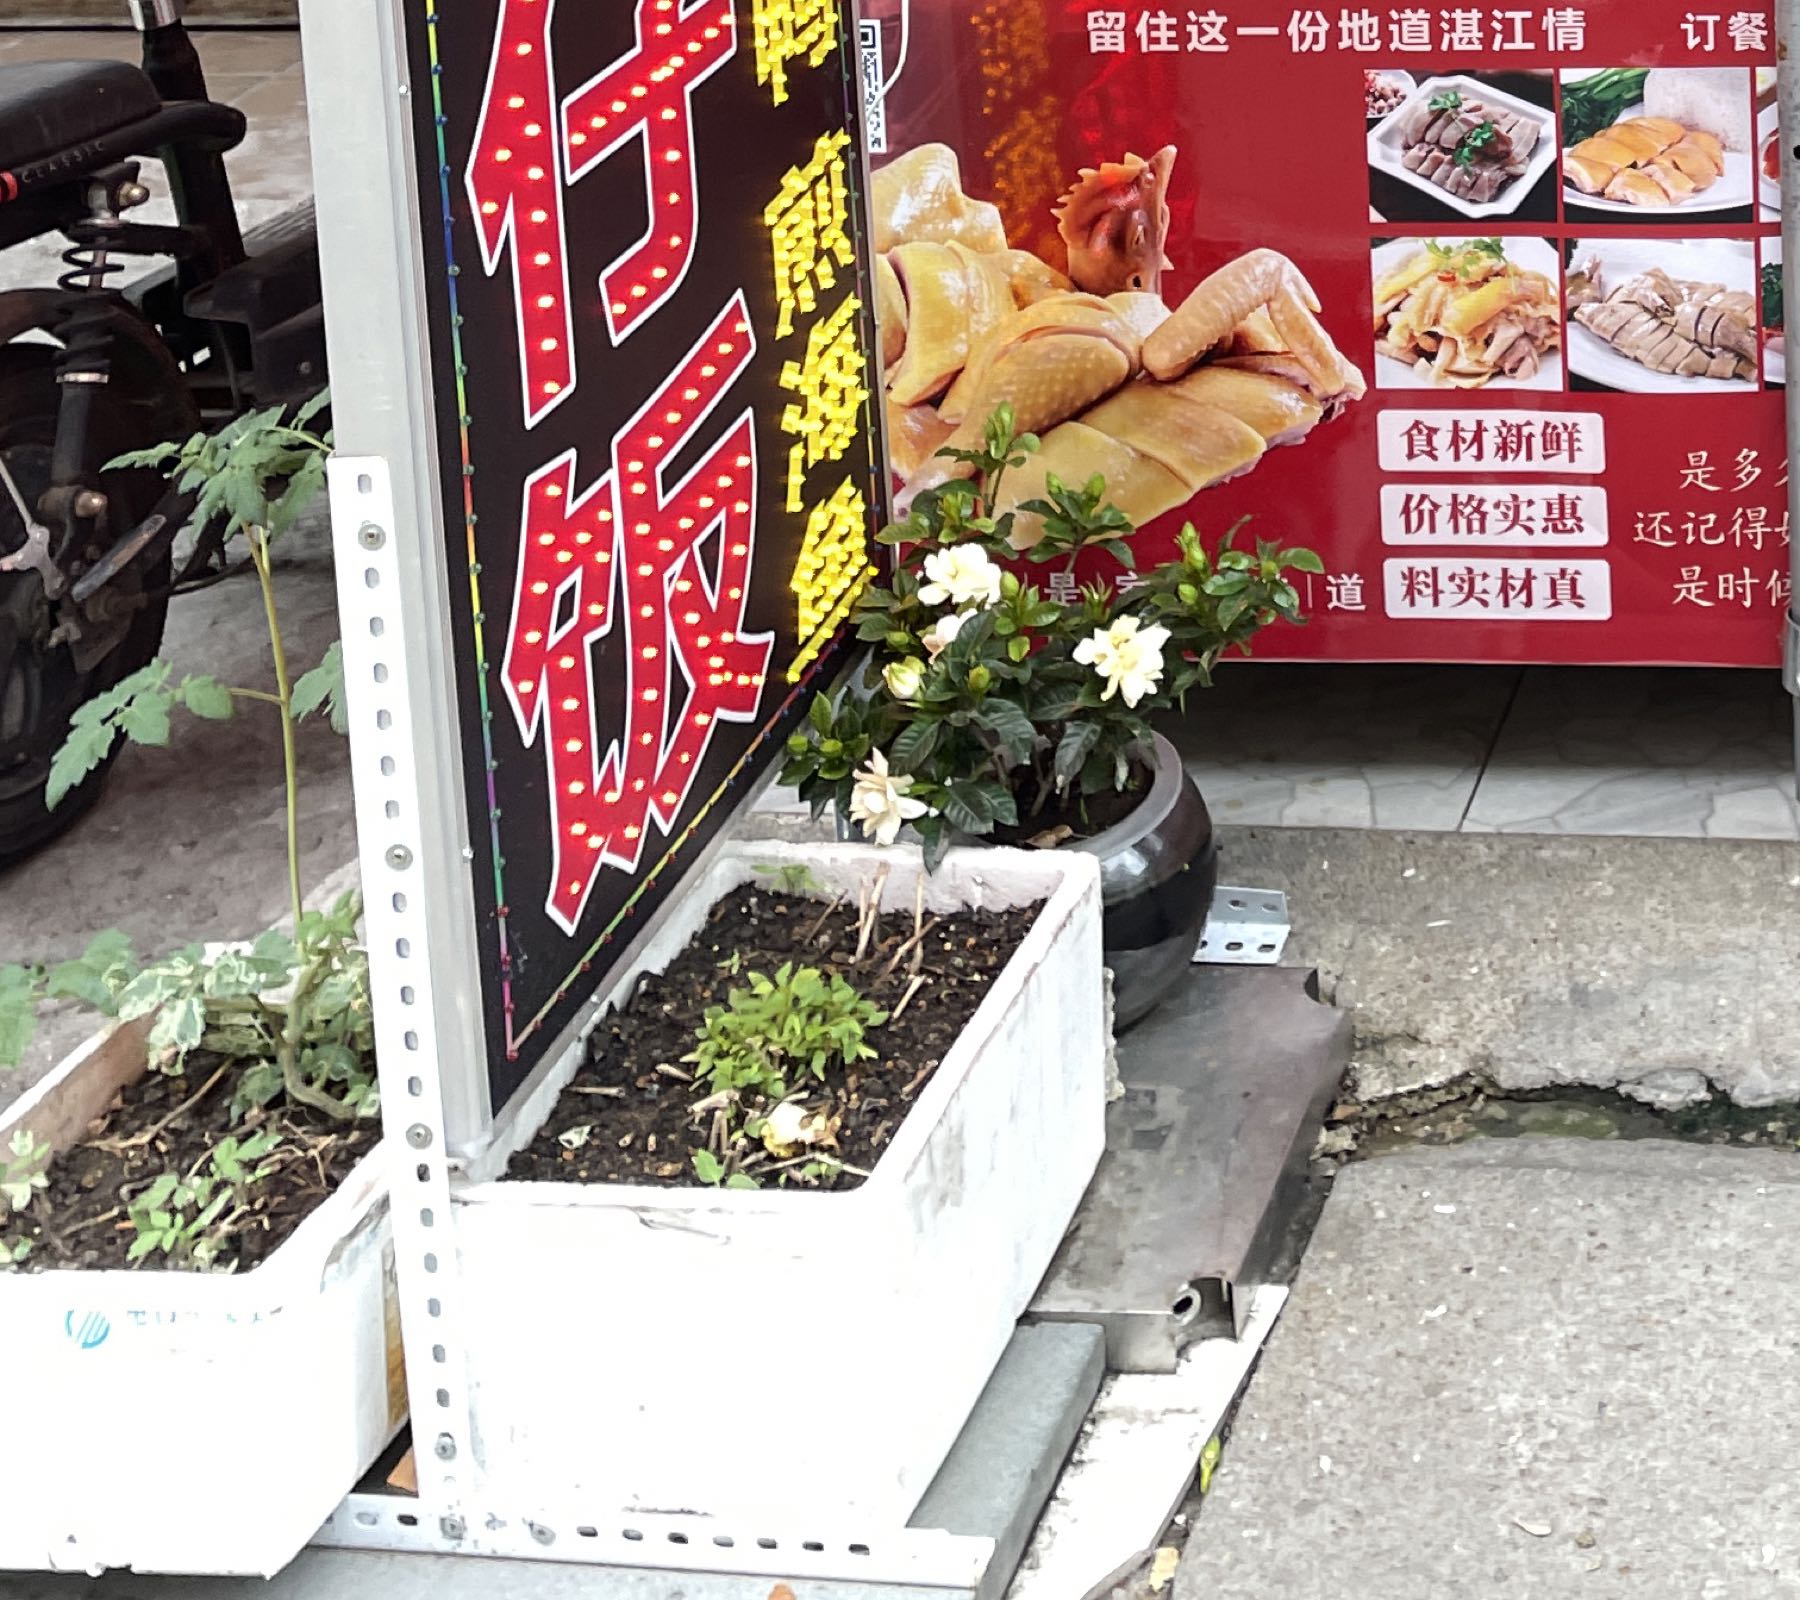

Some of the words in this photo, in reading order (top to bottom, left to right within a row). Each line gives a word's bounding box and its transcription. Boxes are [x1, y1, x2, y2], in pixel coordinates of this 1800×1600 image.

[1086, 7, 1587, 54] 留住这一份地道湛江情
[1401, 417, 1585, 464] 食材新鲜
[1398, 490, 1585, 538] 价格实惠
[1325, 573, 1368, 612] 道
[1399, 564, 1586, 611] 料实材真
